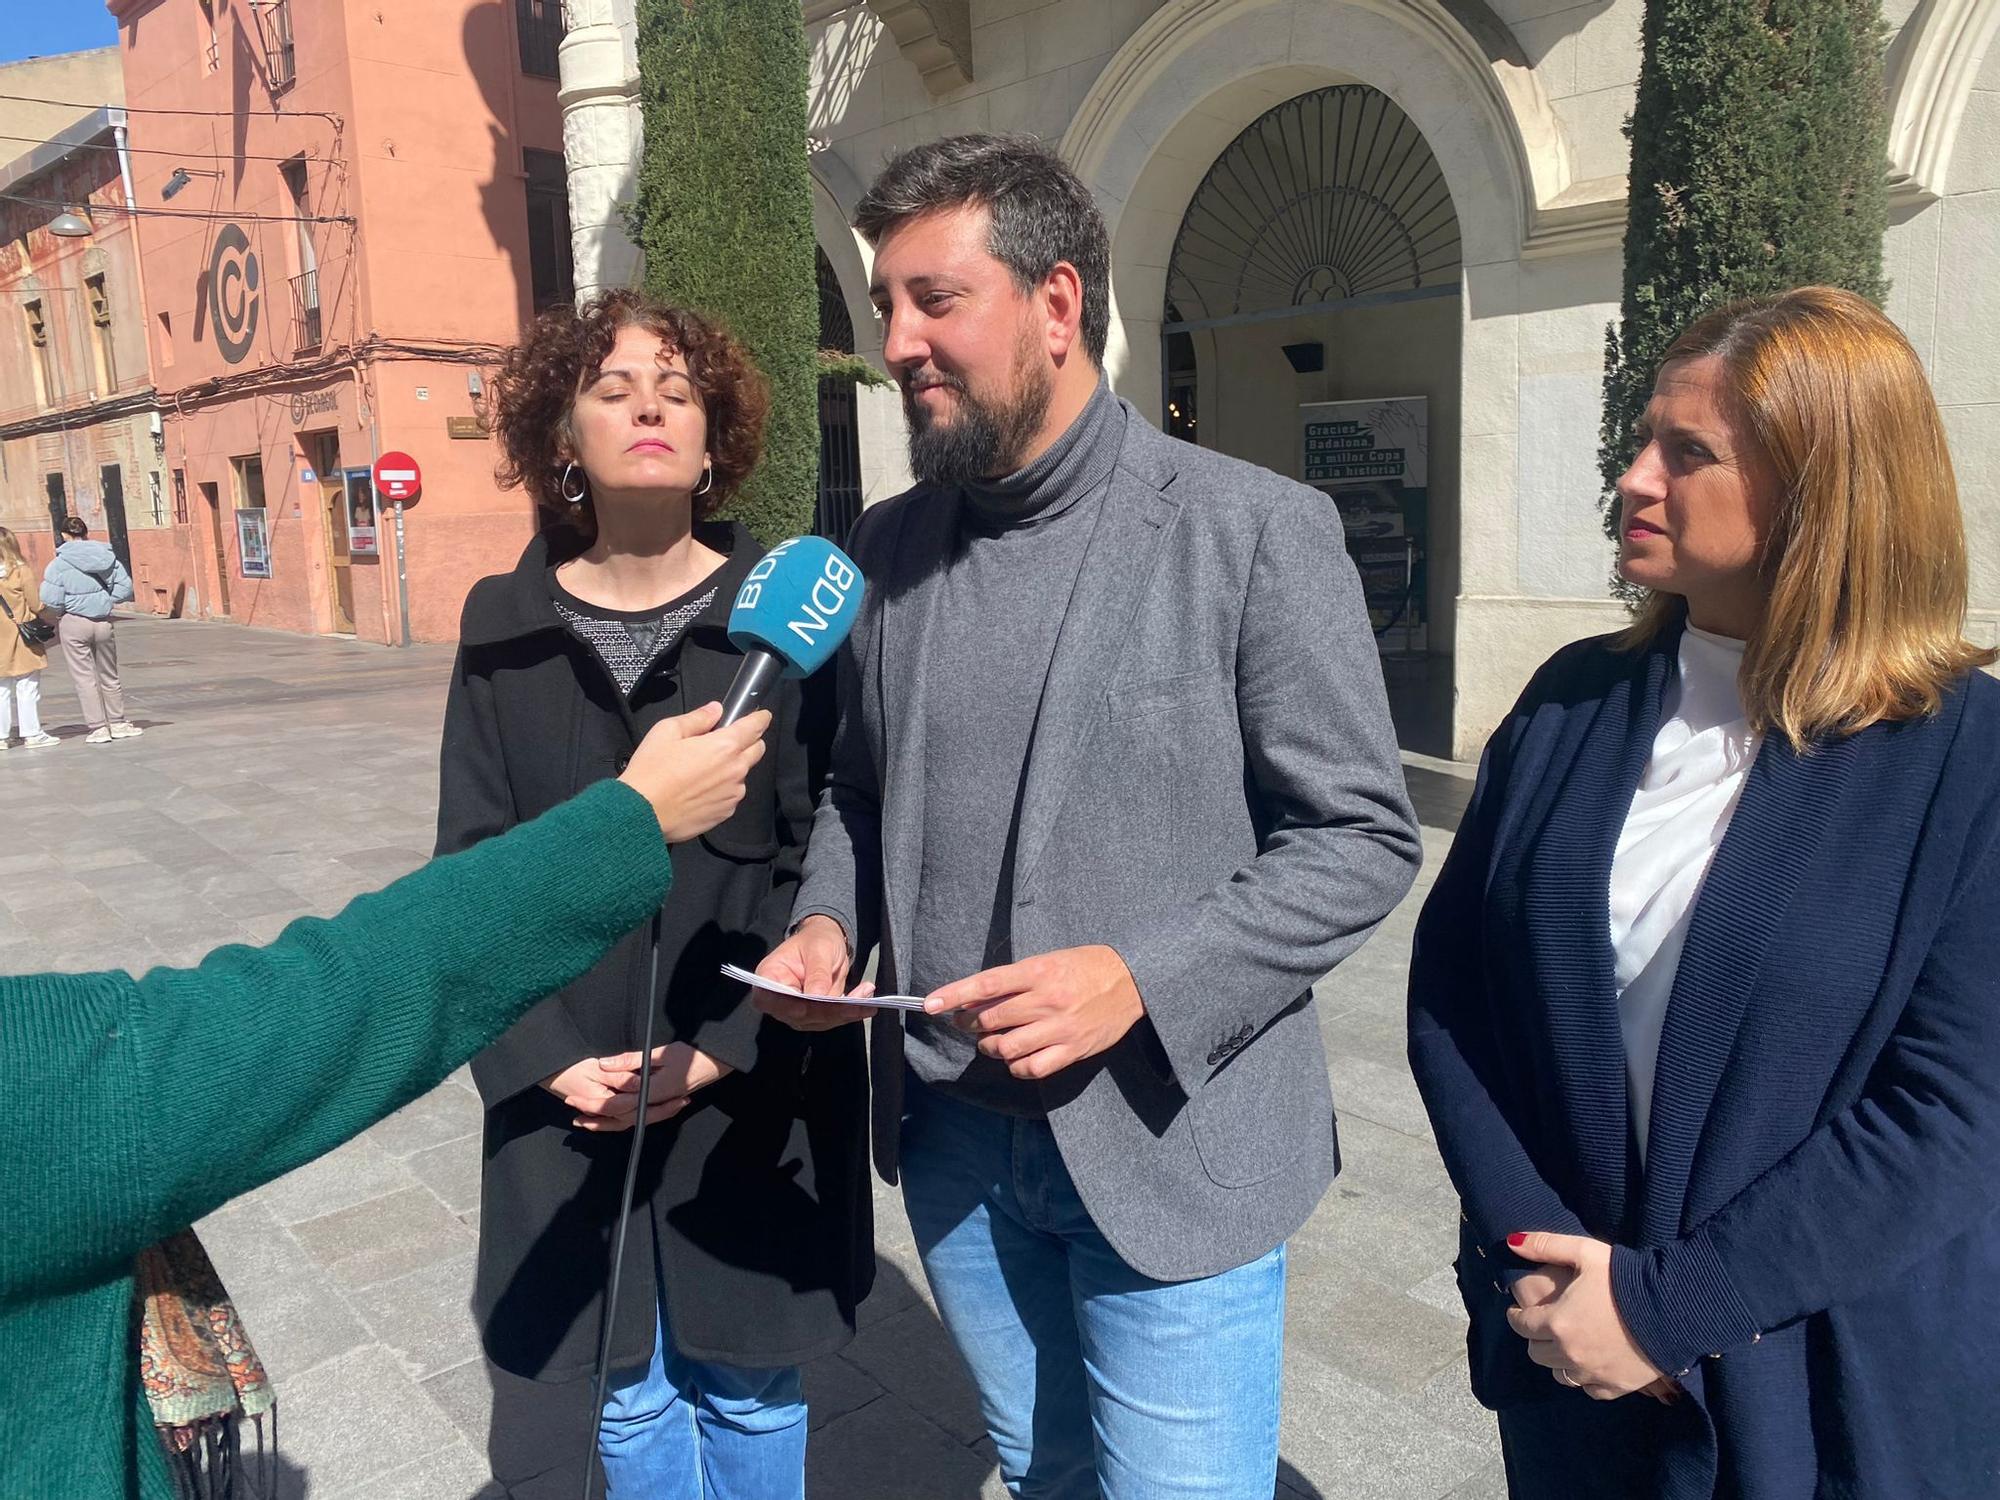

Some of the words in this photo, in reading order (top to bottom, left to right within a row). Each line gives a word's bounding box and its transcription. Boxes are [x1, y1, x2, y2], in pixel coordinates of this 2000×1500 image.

[1309, 454, 1321, 465] la
[1326, 452, 1364, 463] millor
[1368, 451, 1400, 463] Copa
[1309, 468, 1324, 478] de
[1329, 466, 1341, 477] la
[1345, 464, 1401, 477] historia!
[737, 538, 800, 609] BDN
[787, 553, 855, 646] BDN
